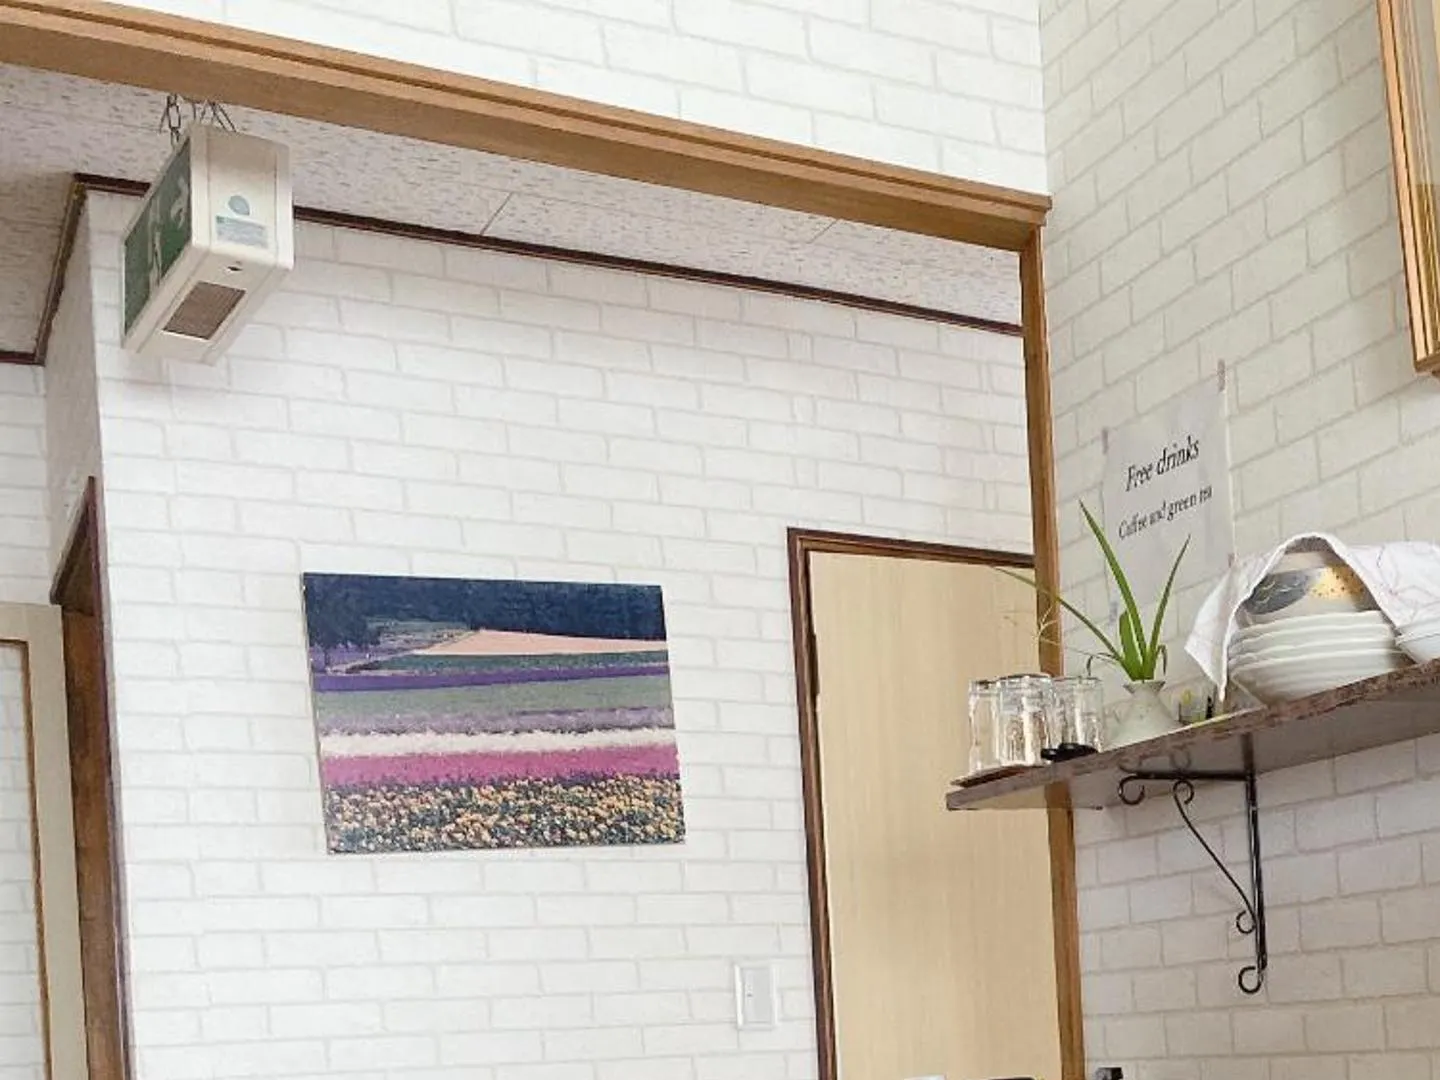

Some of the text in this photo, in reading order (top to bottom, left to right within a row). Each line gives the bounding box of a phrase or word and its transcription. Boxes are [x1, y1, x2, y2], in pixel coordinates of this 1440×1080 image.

[1125, 435, 1200, 492] Free drinks
[1118, 511, 1147, 540] Coffee
[1149, 500, 1166, 525] and
[1167, 493, 1197, 521] green
